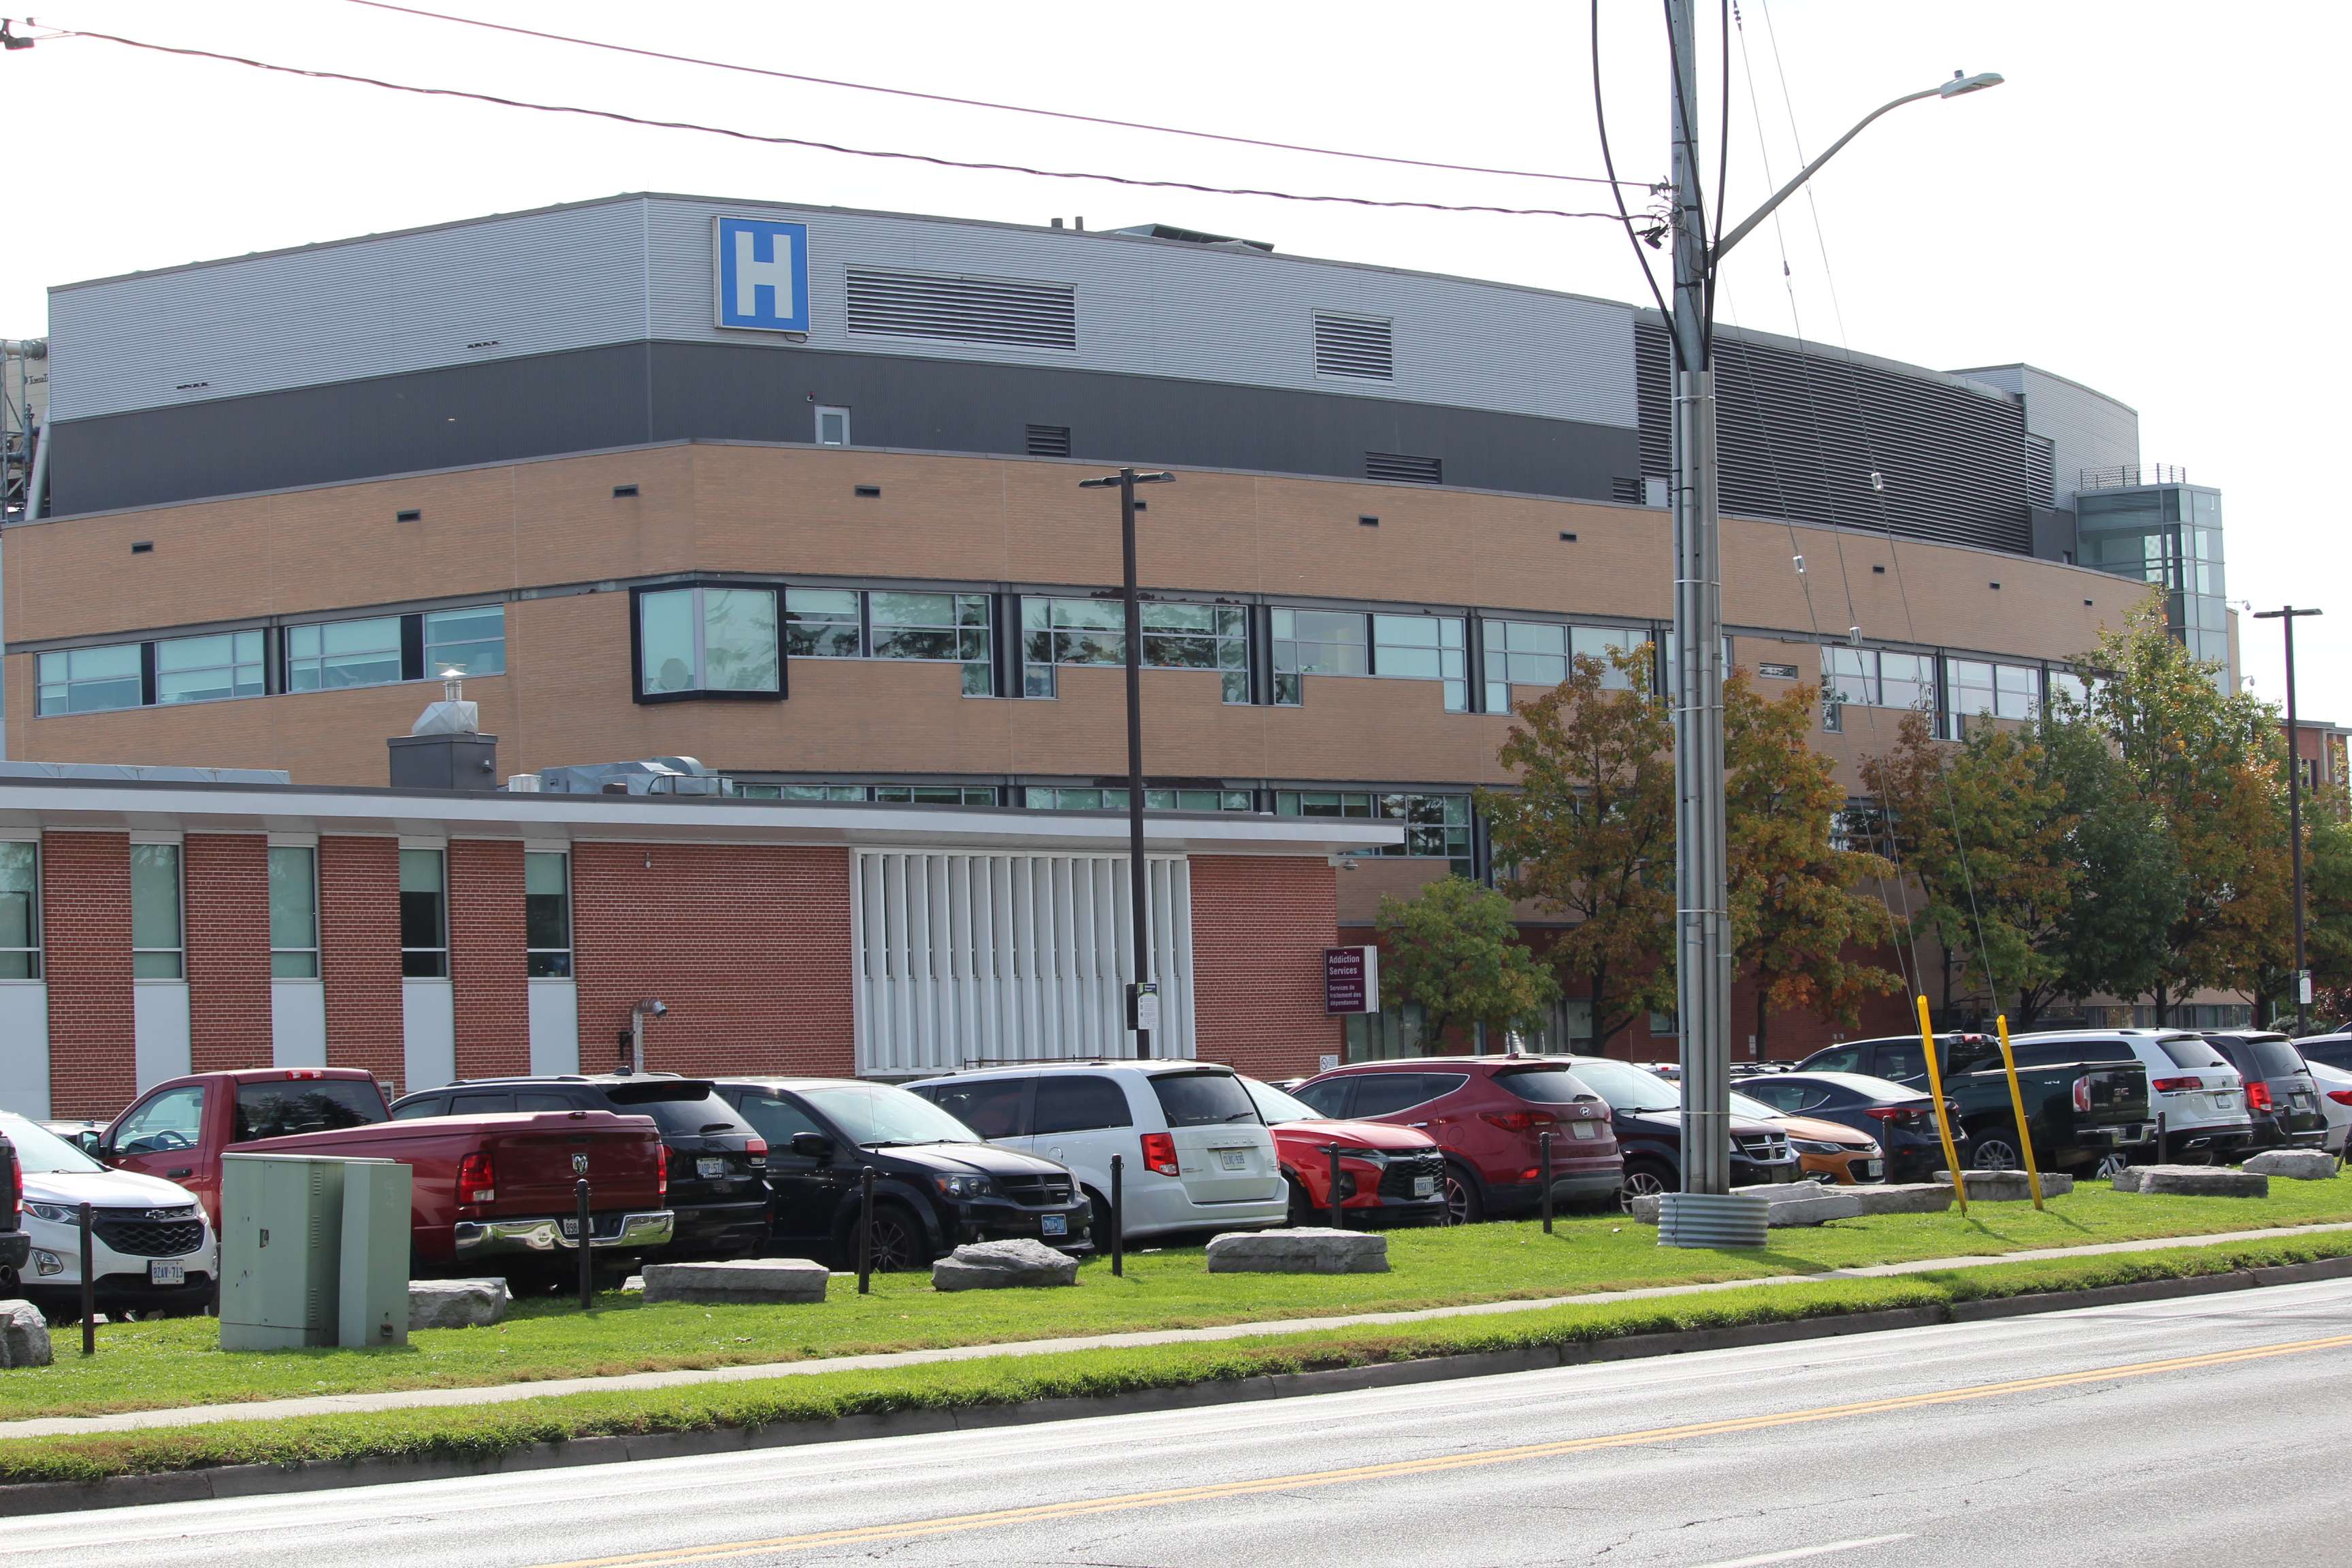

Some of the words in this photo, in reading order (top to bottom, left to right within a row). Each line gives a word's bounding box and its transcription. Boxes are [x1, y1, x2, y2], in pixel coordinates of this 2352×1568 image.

[735, 231, 794, 319] H
[1329, 955, 1360, 964] Addiction
[1329, 966, 1357, 975] Services
